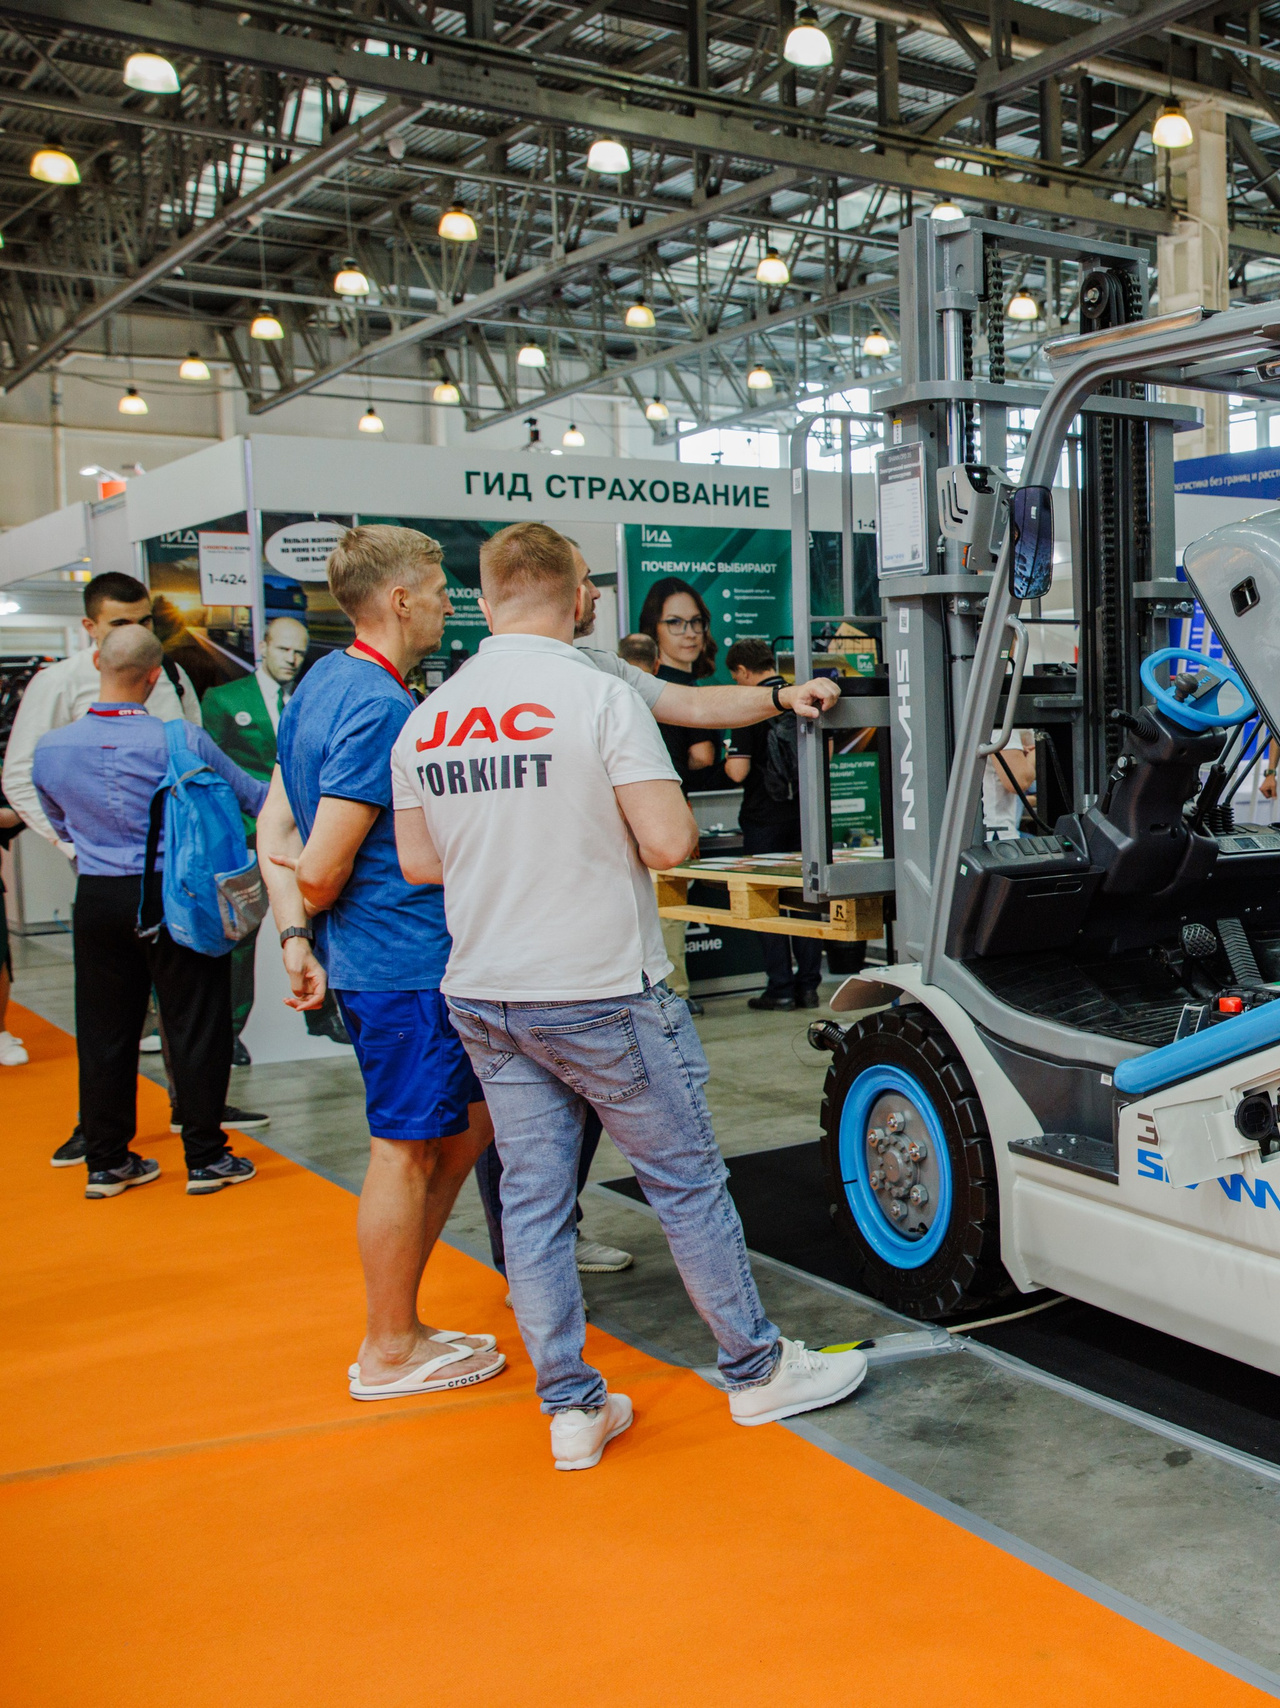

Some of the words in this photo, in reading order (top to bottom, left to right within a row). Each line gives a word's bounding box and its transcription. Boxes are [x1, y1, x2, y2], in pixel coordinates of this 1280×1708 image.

[465, 471, 532, 501] ГИД
[545, 474, 770, 508] СТРАХОВАНИЕ
[1210, 476, 1223, 487] без
[1224, 473, 1250, 487] границ
[208, 573, 248, 585] 1-424
[641, 560, 690, 572] ПОЧЕМУ
[692, 561, 716, 573] НАС
[717, 562, 777, 574] ВЫБИРАЮТ
[416, 703, 556, 752] JAC
[896, 649, 916, 830] SHANN
[416, 754, 552, 797] FORKLIFT
[447, 1374, 480, 1388] crocs
